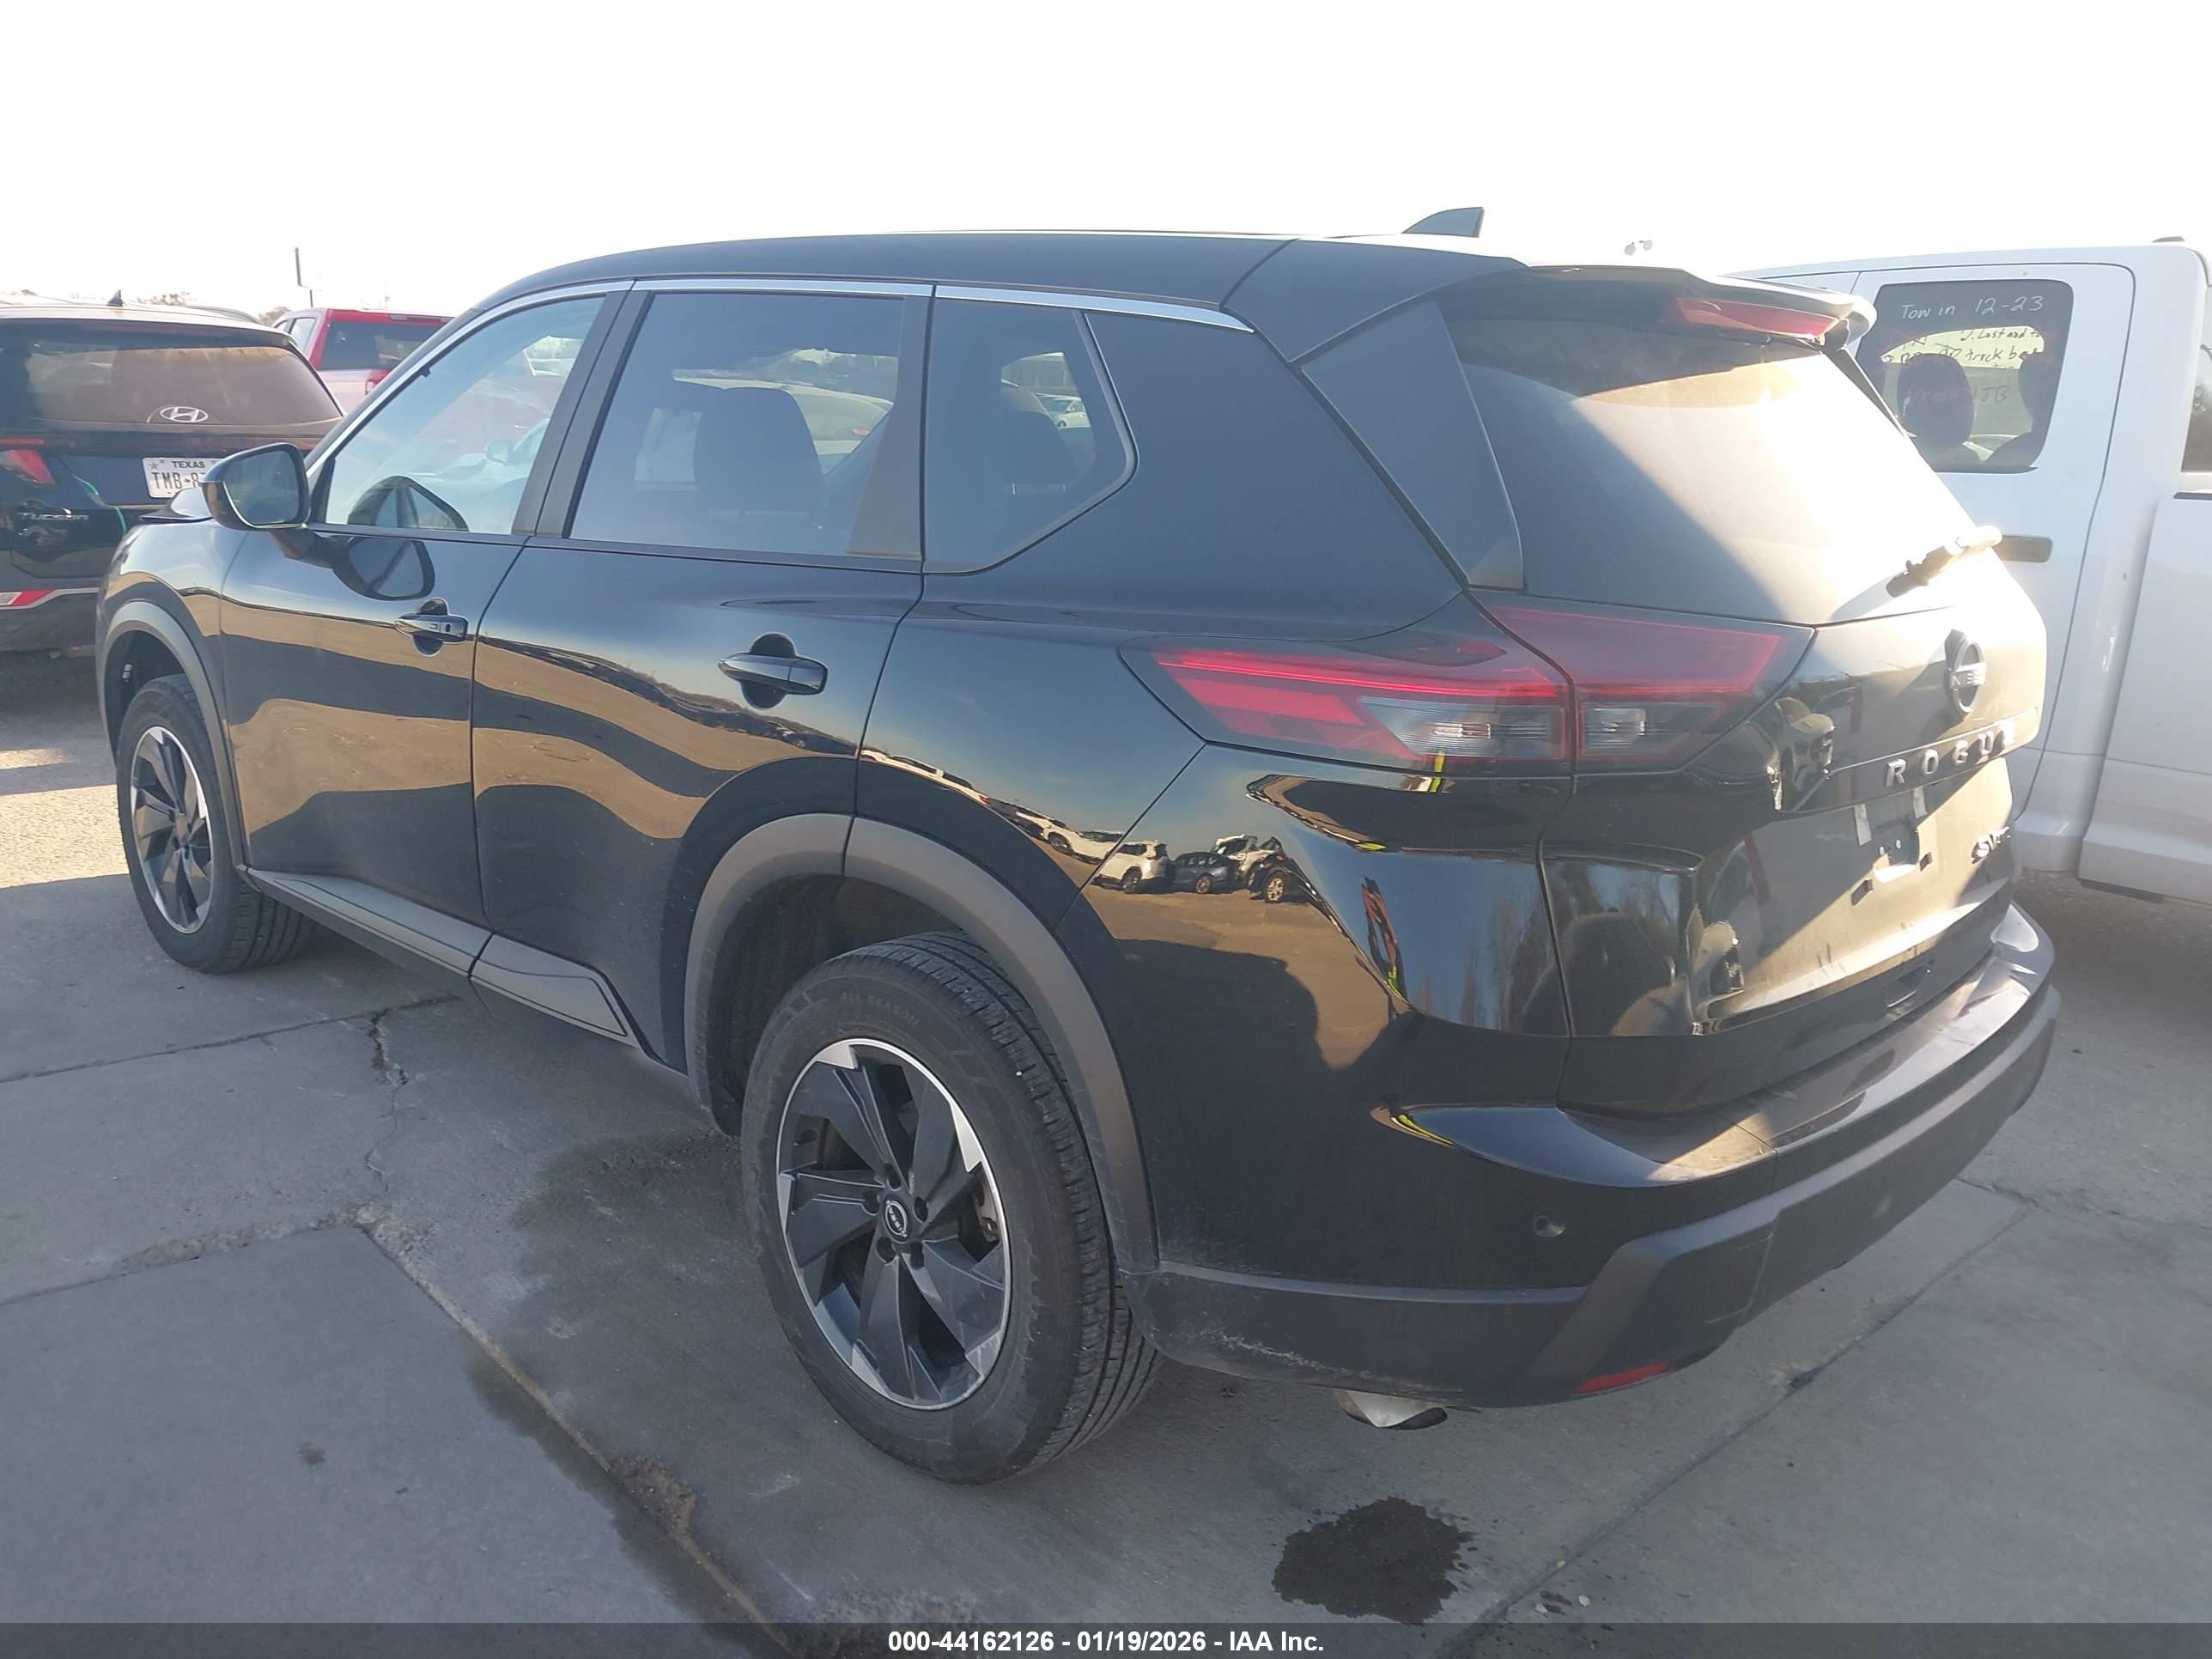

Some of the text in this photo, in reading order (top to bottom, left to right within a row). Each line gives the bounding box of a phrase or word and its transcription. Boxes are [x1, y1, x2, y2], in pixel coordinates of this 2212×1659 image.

[1901, 295, 2045, 319] Tow in 12-23
[172, 460, 206, 469] TEXAS
[1886, 722, 2015, 787] ROGU
